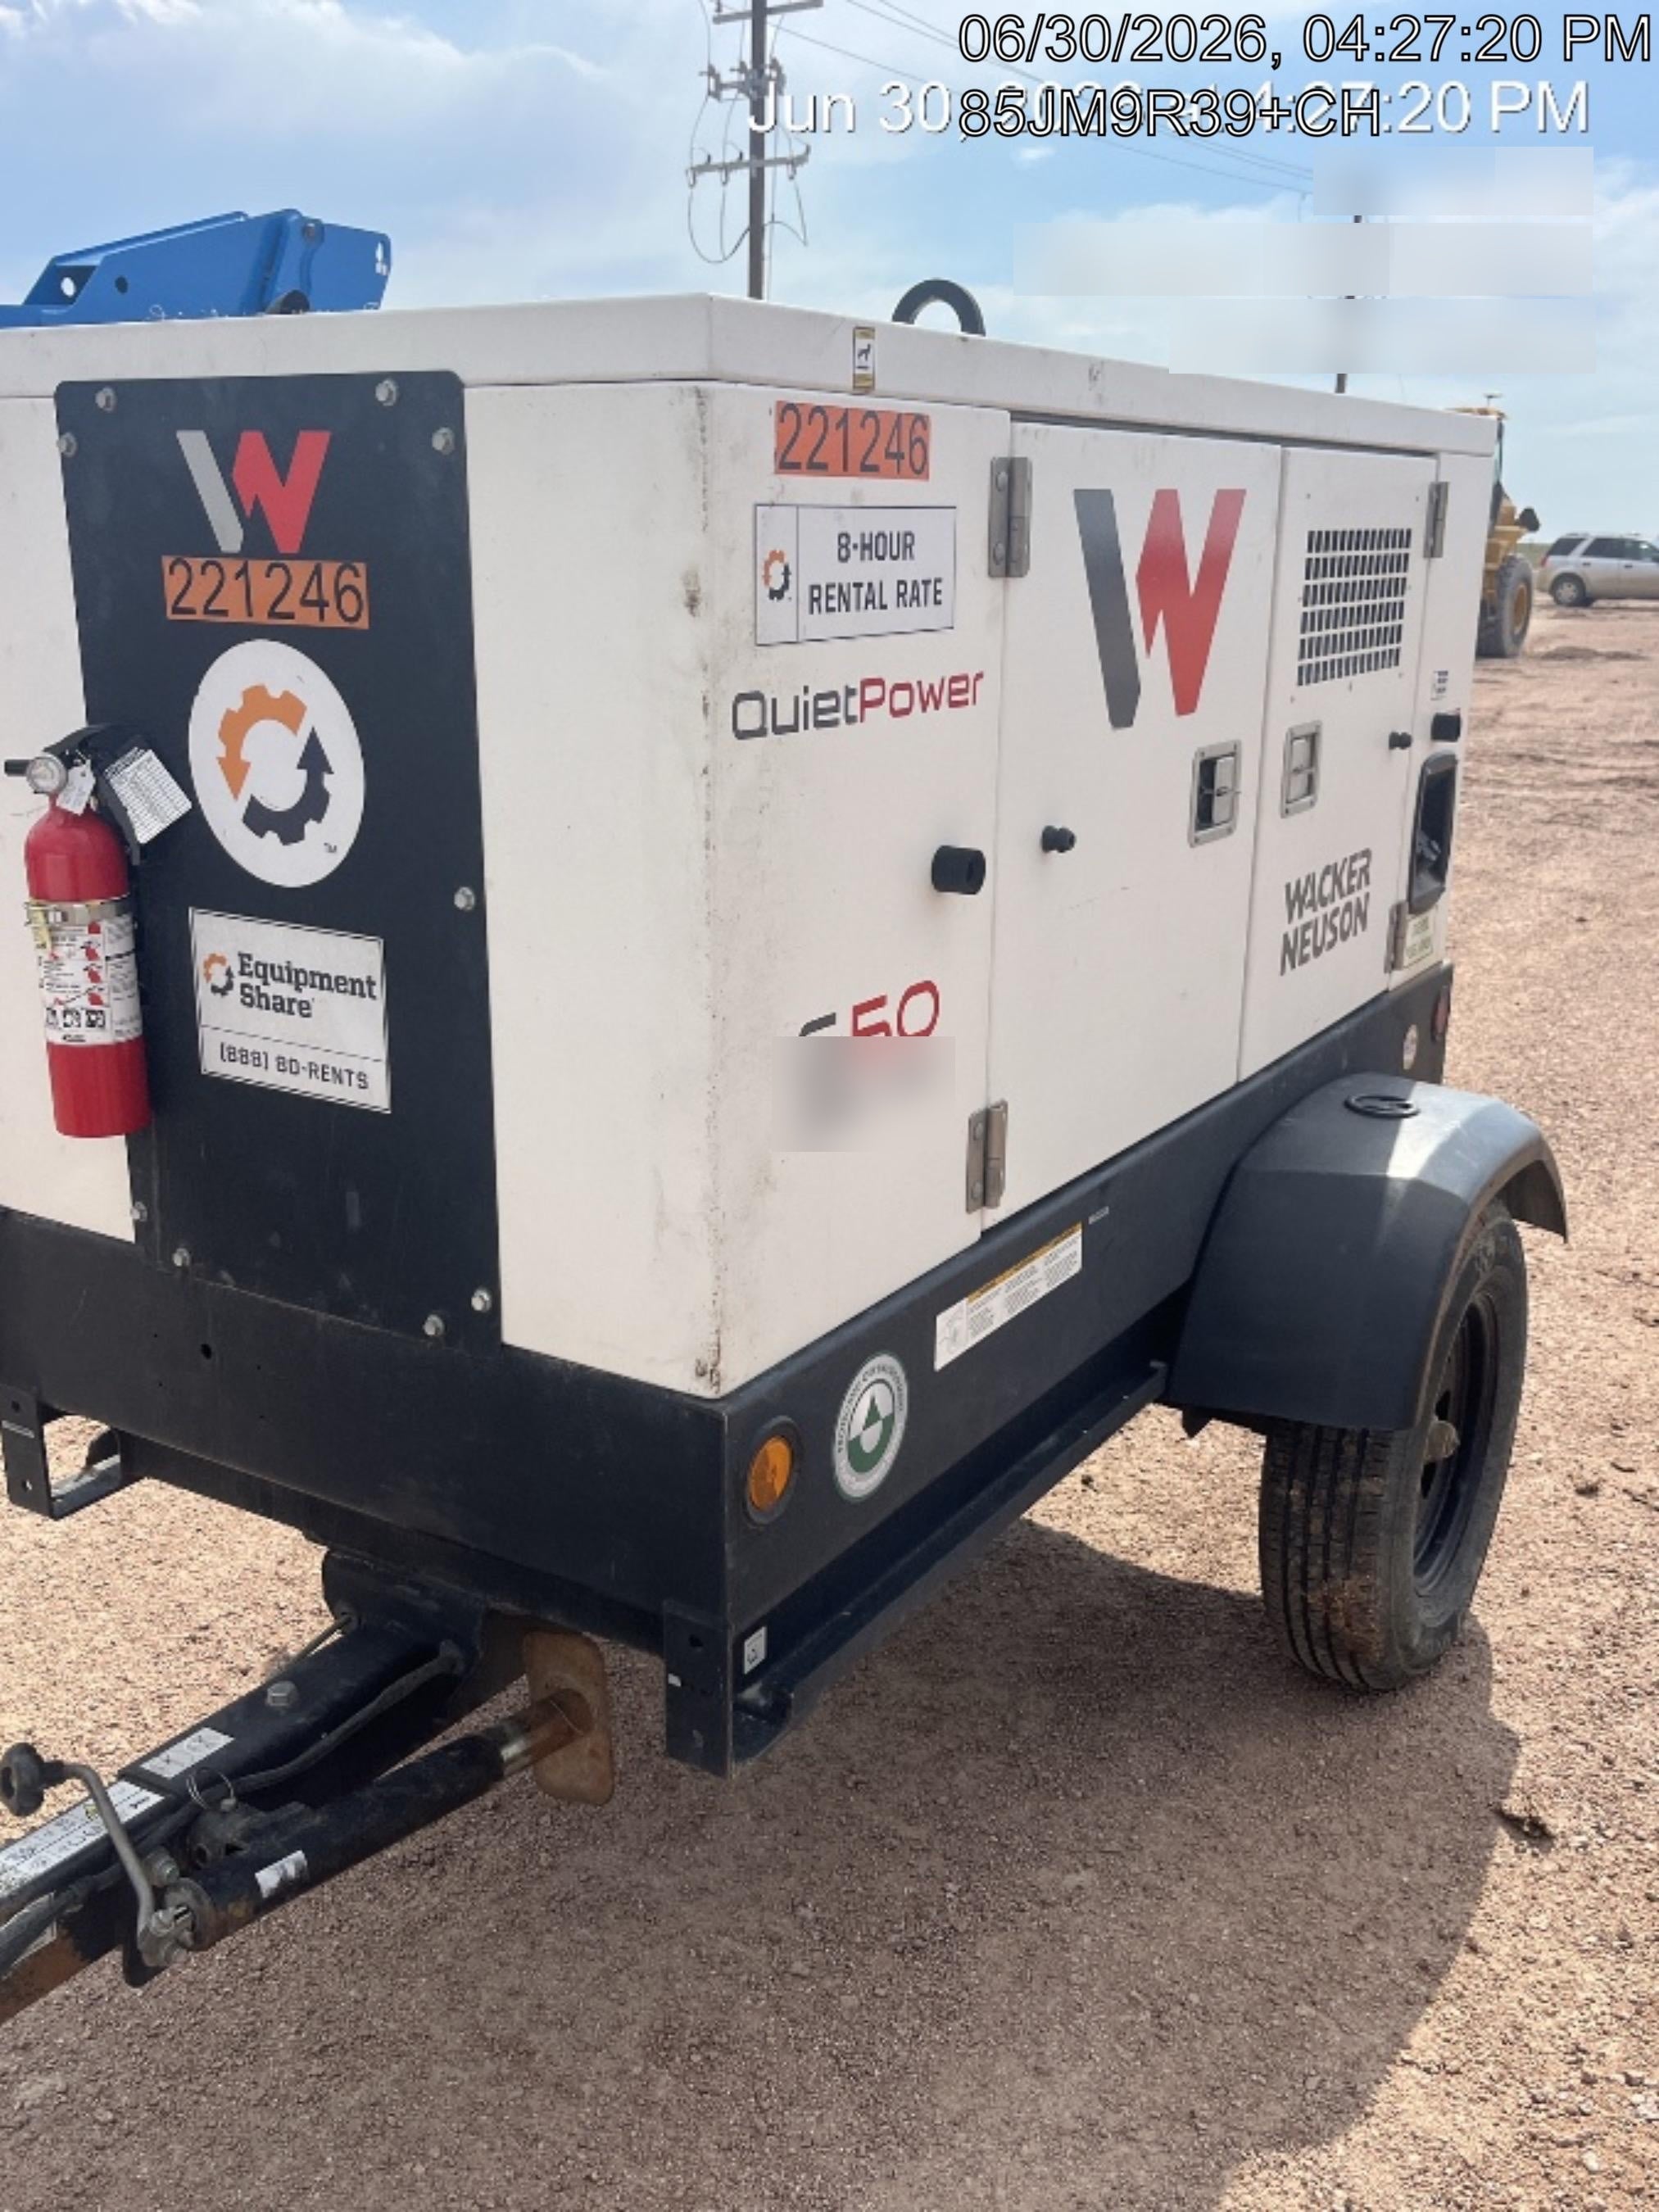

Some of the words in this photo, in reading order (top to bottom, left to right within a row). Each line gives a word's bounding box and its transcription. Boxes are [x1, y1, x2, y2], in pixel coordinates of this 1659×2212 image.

[778, 403, 928, 475] 221246
[837, 531, 915, 563] 8-HOUR
[169, 558, 363, 623] 221246
[809, 581, 888, 615] RENTAL
[896, 578, 943, 609] RATE
[732, 671, 985, 741] QuietPower
[1285, 848, 1371, 924] WACKER
[1281, 891, 1370, 976] NEUSON
[238, 951, 377, 1000] Equipment
[240, 983, 312, 1018] Share
